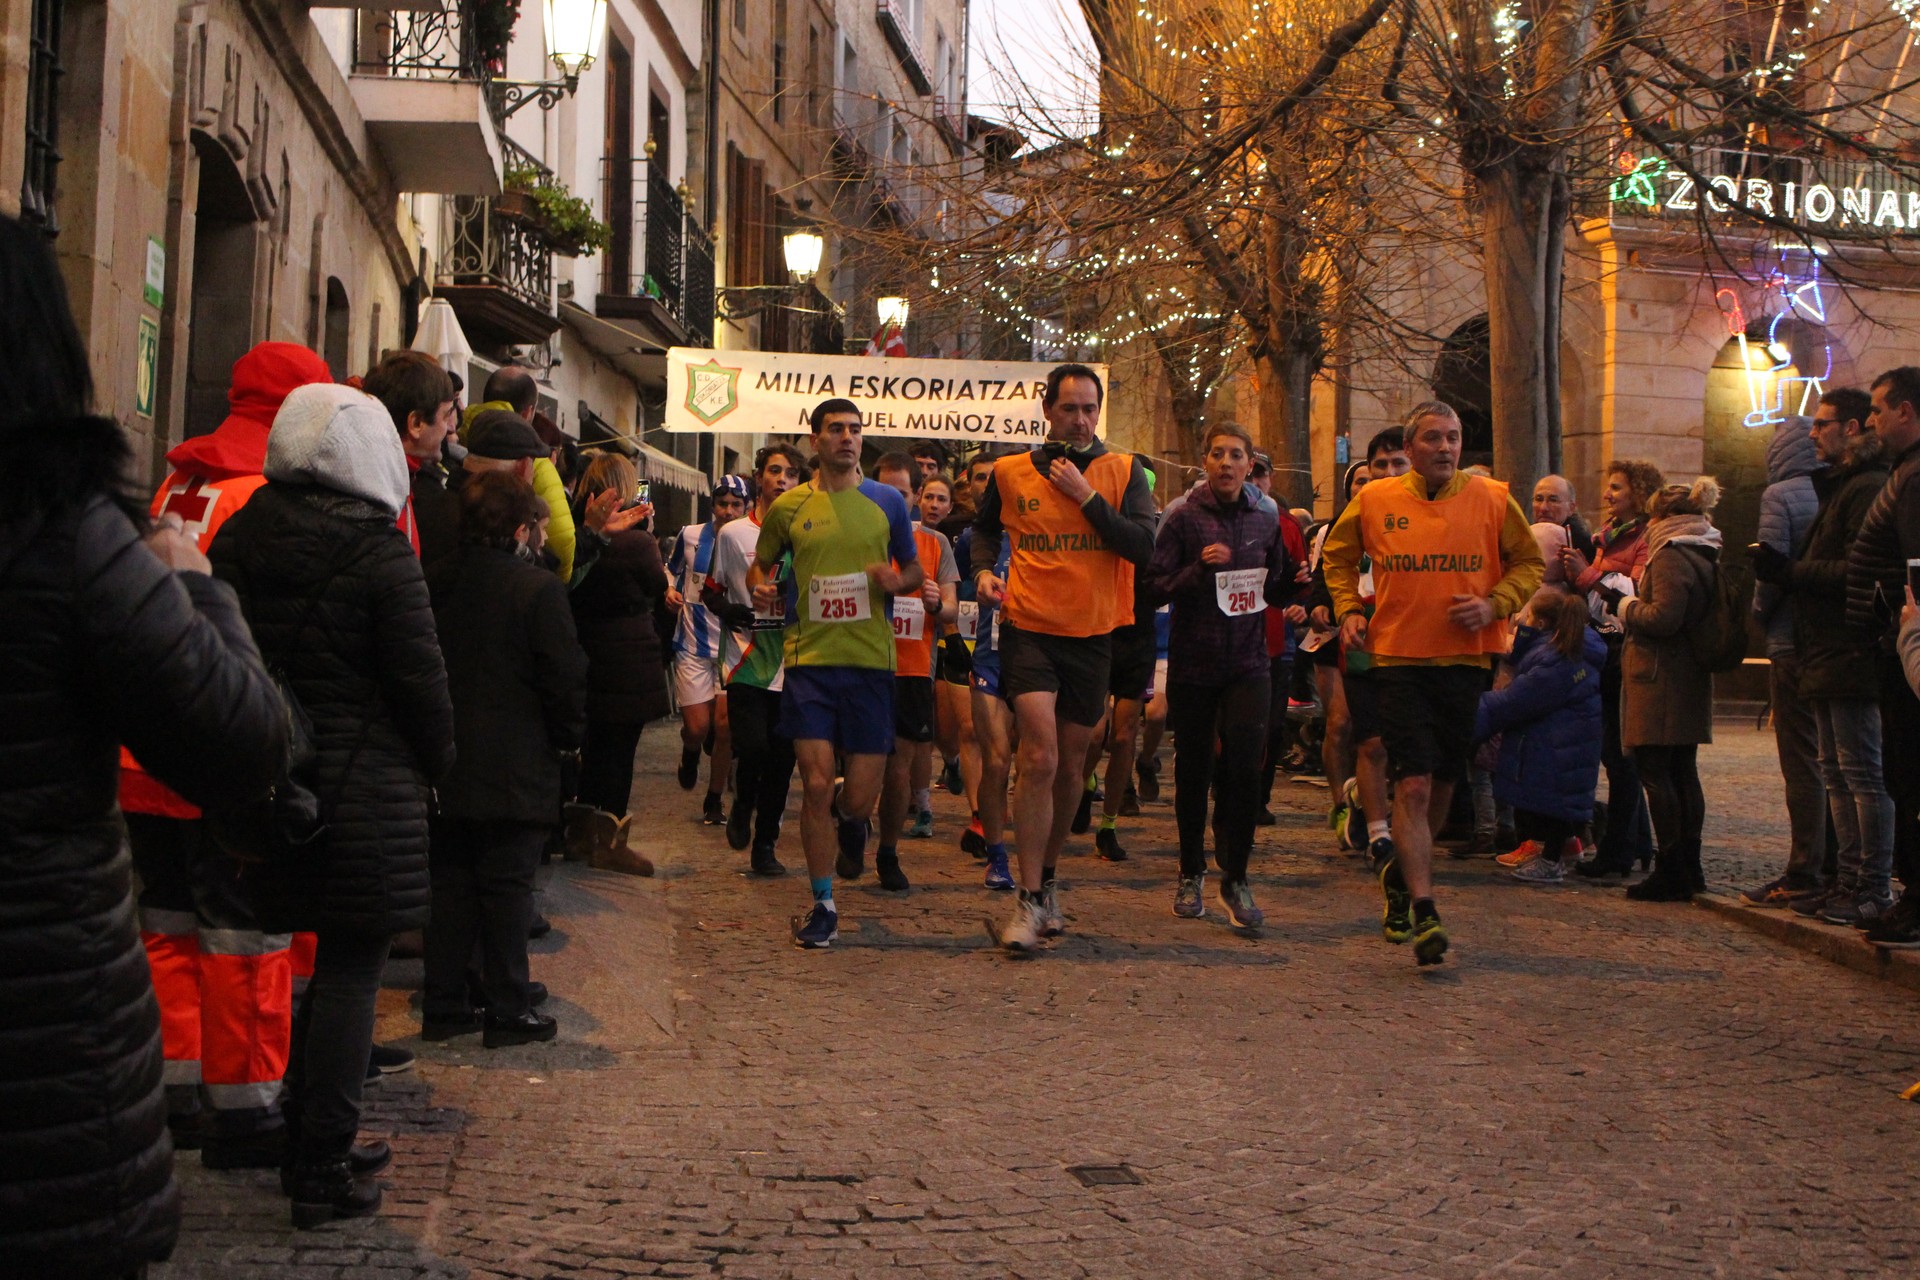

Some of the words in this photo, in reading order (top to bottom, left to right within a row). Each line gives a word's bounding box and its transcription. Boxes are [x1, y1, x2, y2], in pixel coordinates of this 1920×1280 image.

[755, 371, 836, 396] MILIA
[848, 375, 1047, 401] ESKORIATZAR
[798, 408, 897, 428] MUEL
[905, 410, 996, 433] MUÑOZ
[1018, 533, 1108, 552] ANTOLATZAIL
[820, 597, 857, 619] 235
[1228, 590, 1256, 612] 250
